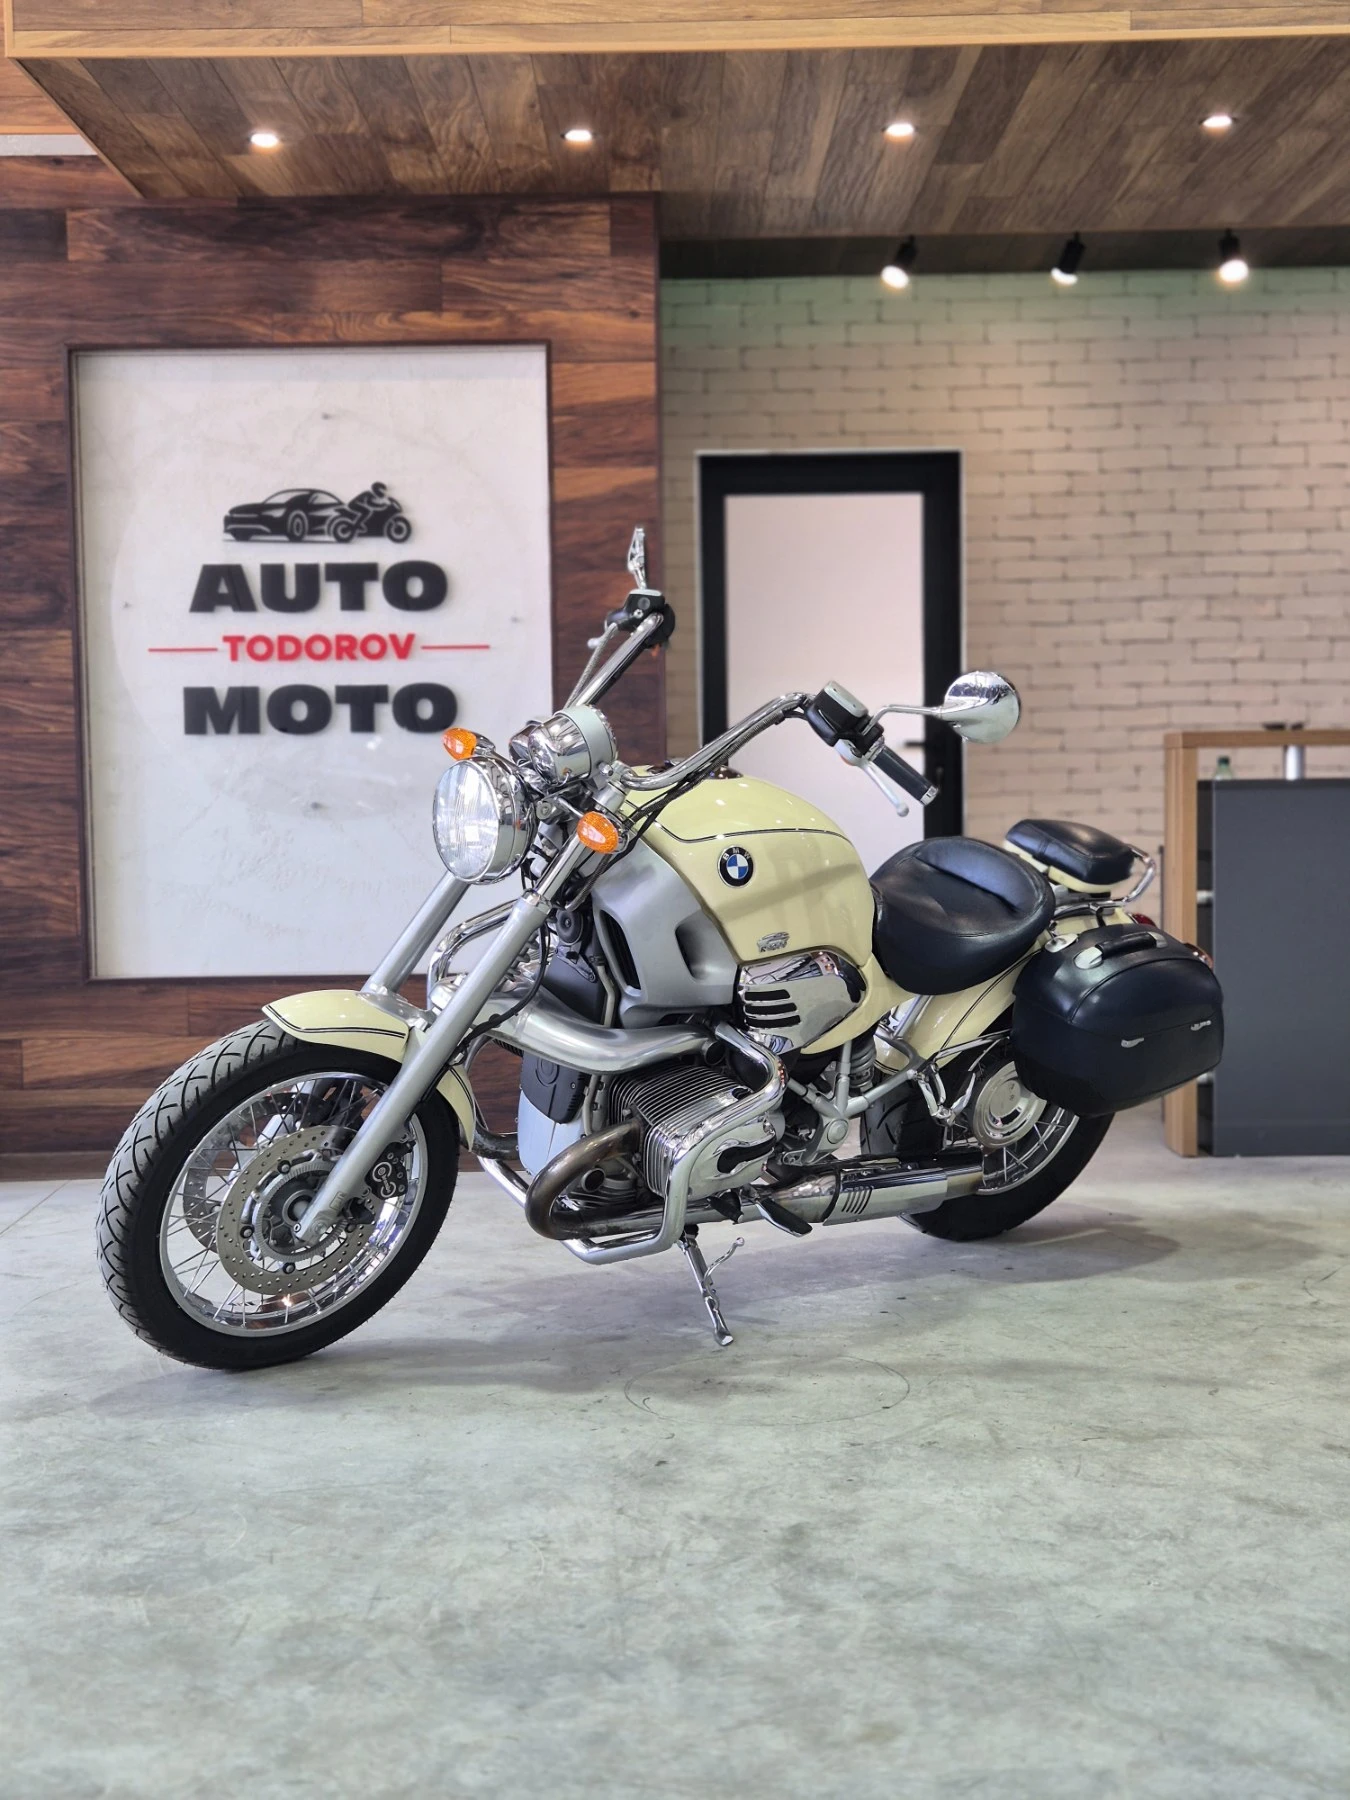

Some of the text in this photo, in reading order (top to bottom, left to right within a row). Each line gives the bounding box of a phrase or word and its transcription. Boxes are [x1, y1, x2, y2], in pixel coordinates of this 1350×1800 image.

[189, 560, 449, 613] AUTO
[222, 633, 416, 663] TODOROV
[183, 683, 459, 736] MOTO
[722, 847, 751, 861] BMW
